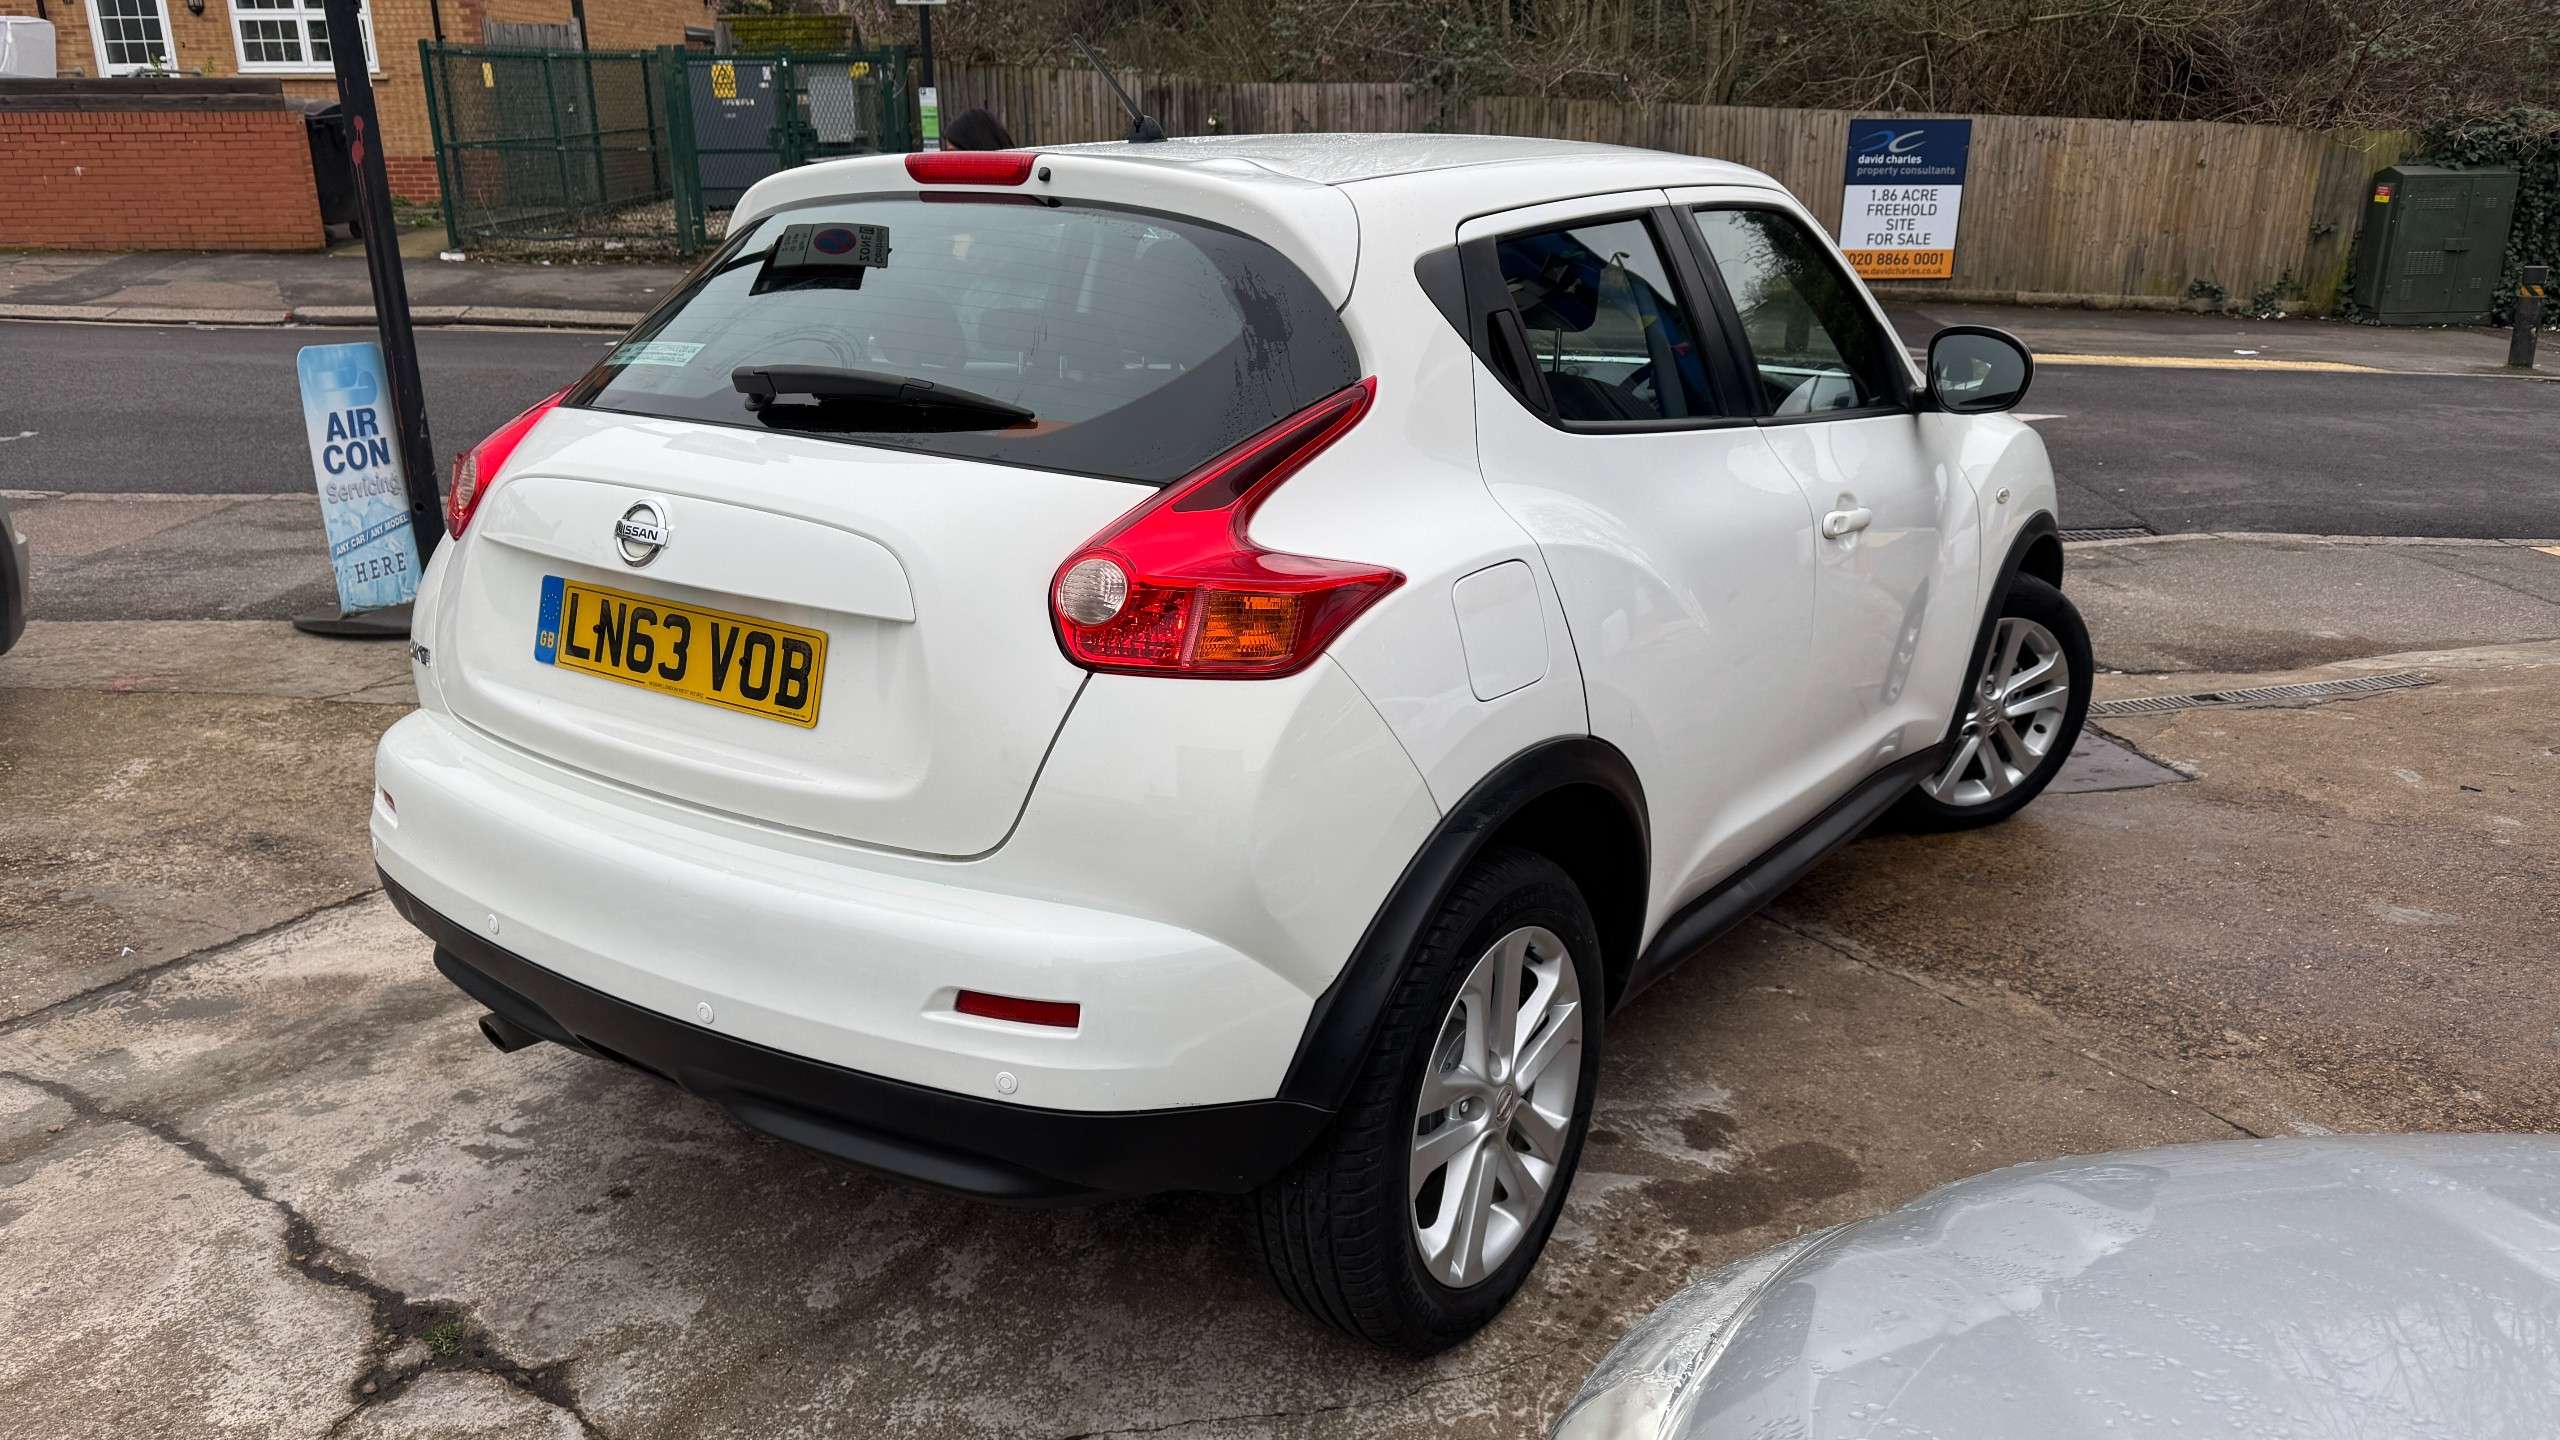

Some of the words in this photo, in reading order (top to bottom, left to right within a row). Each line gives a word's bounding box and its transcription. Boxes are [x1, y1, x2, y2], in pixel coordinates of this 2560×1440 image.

[1858, 154, 1884, 164] david
[1886, 154, 1922, 164] charles
[1857, 166, 1898, 176] property
[1900, 165, 1955, 175] consultants
[1872, 189, 1898, 202] 1.86
[1901, 189, 1938, 201] ACRE
[1867, 204, 1937, 216] FREEHOLD
[1886, 218, 1915, 231] SITE
[1867, 233, 1893, 245] FOR
[1897, 233, 1931, 245] SALE
[1849, 253, 1872, 265] 020
[1877, 253, 1909, 265] 8866
[1914, 253, 1944, 265] 0001
[327, 408, 379, 442] AIR
[323, 437, 390, 474] CON
[327, 476, 402, 504] Servicing
[336, 542, 350, 556] ANY
[351, 535, 365, 548] CAR
[371, 526, 384, 538] ANY
[385, 514, 408, 530] MODEL
[616, 522, 658, 540] NISSAN
[354, 552, 407, 584] HERE
[540, 630, 555, 648] GB
[565, 592, 691, 681] LN63
[711, 622, 812, 709] VOB
